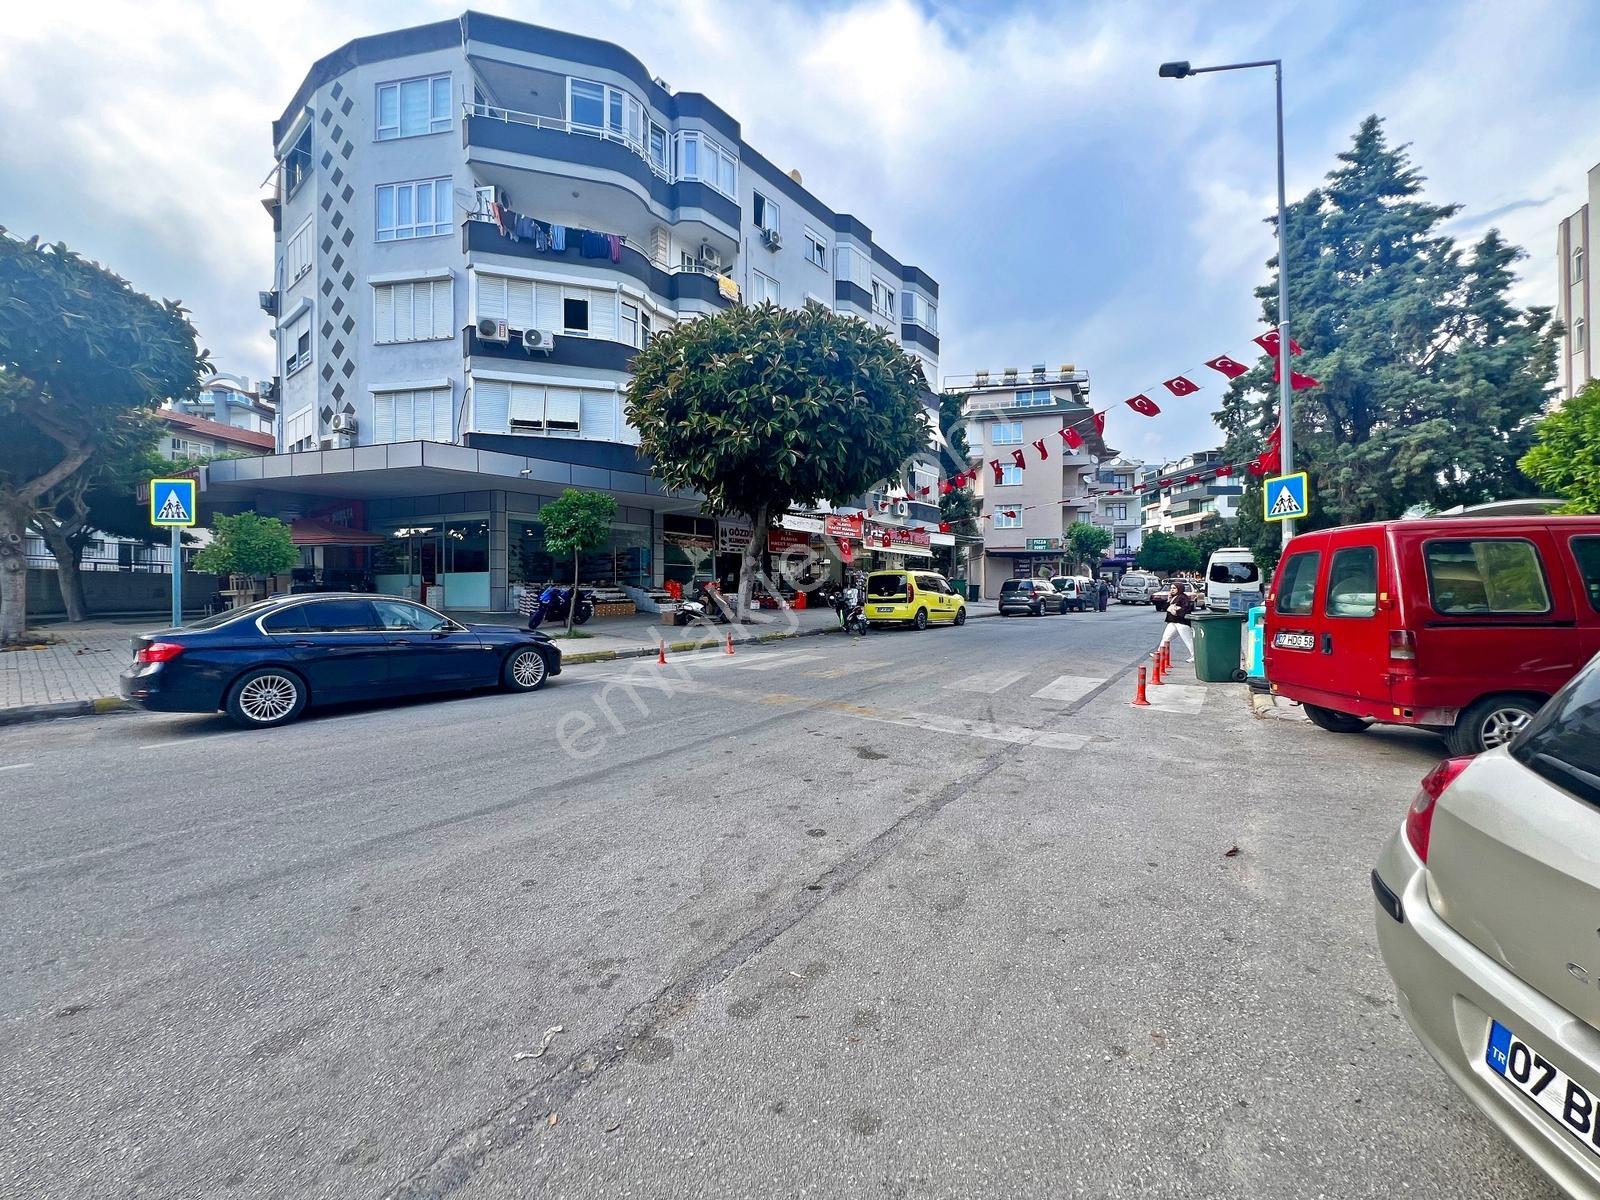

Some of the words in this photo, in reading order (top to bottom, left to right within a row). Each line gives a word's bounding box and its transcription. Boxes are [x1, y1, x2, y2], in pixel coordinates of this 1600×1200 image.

[1304, 636, 1313, 647] 58
[1492, 1046, 1505, 1065] TR
[1509, 1041, 1557, 1096] 07
